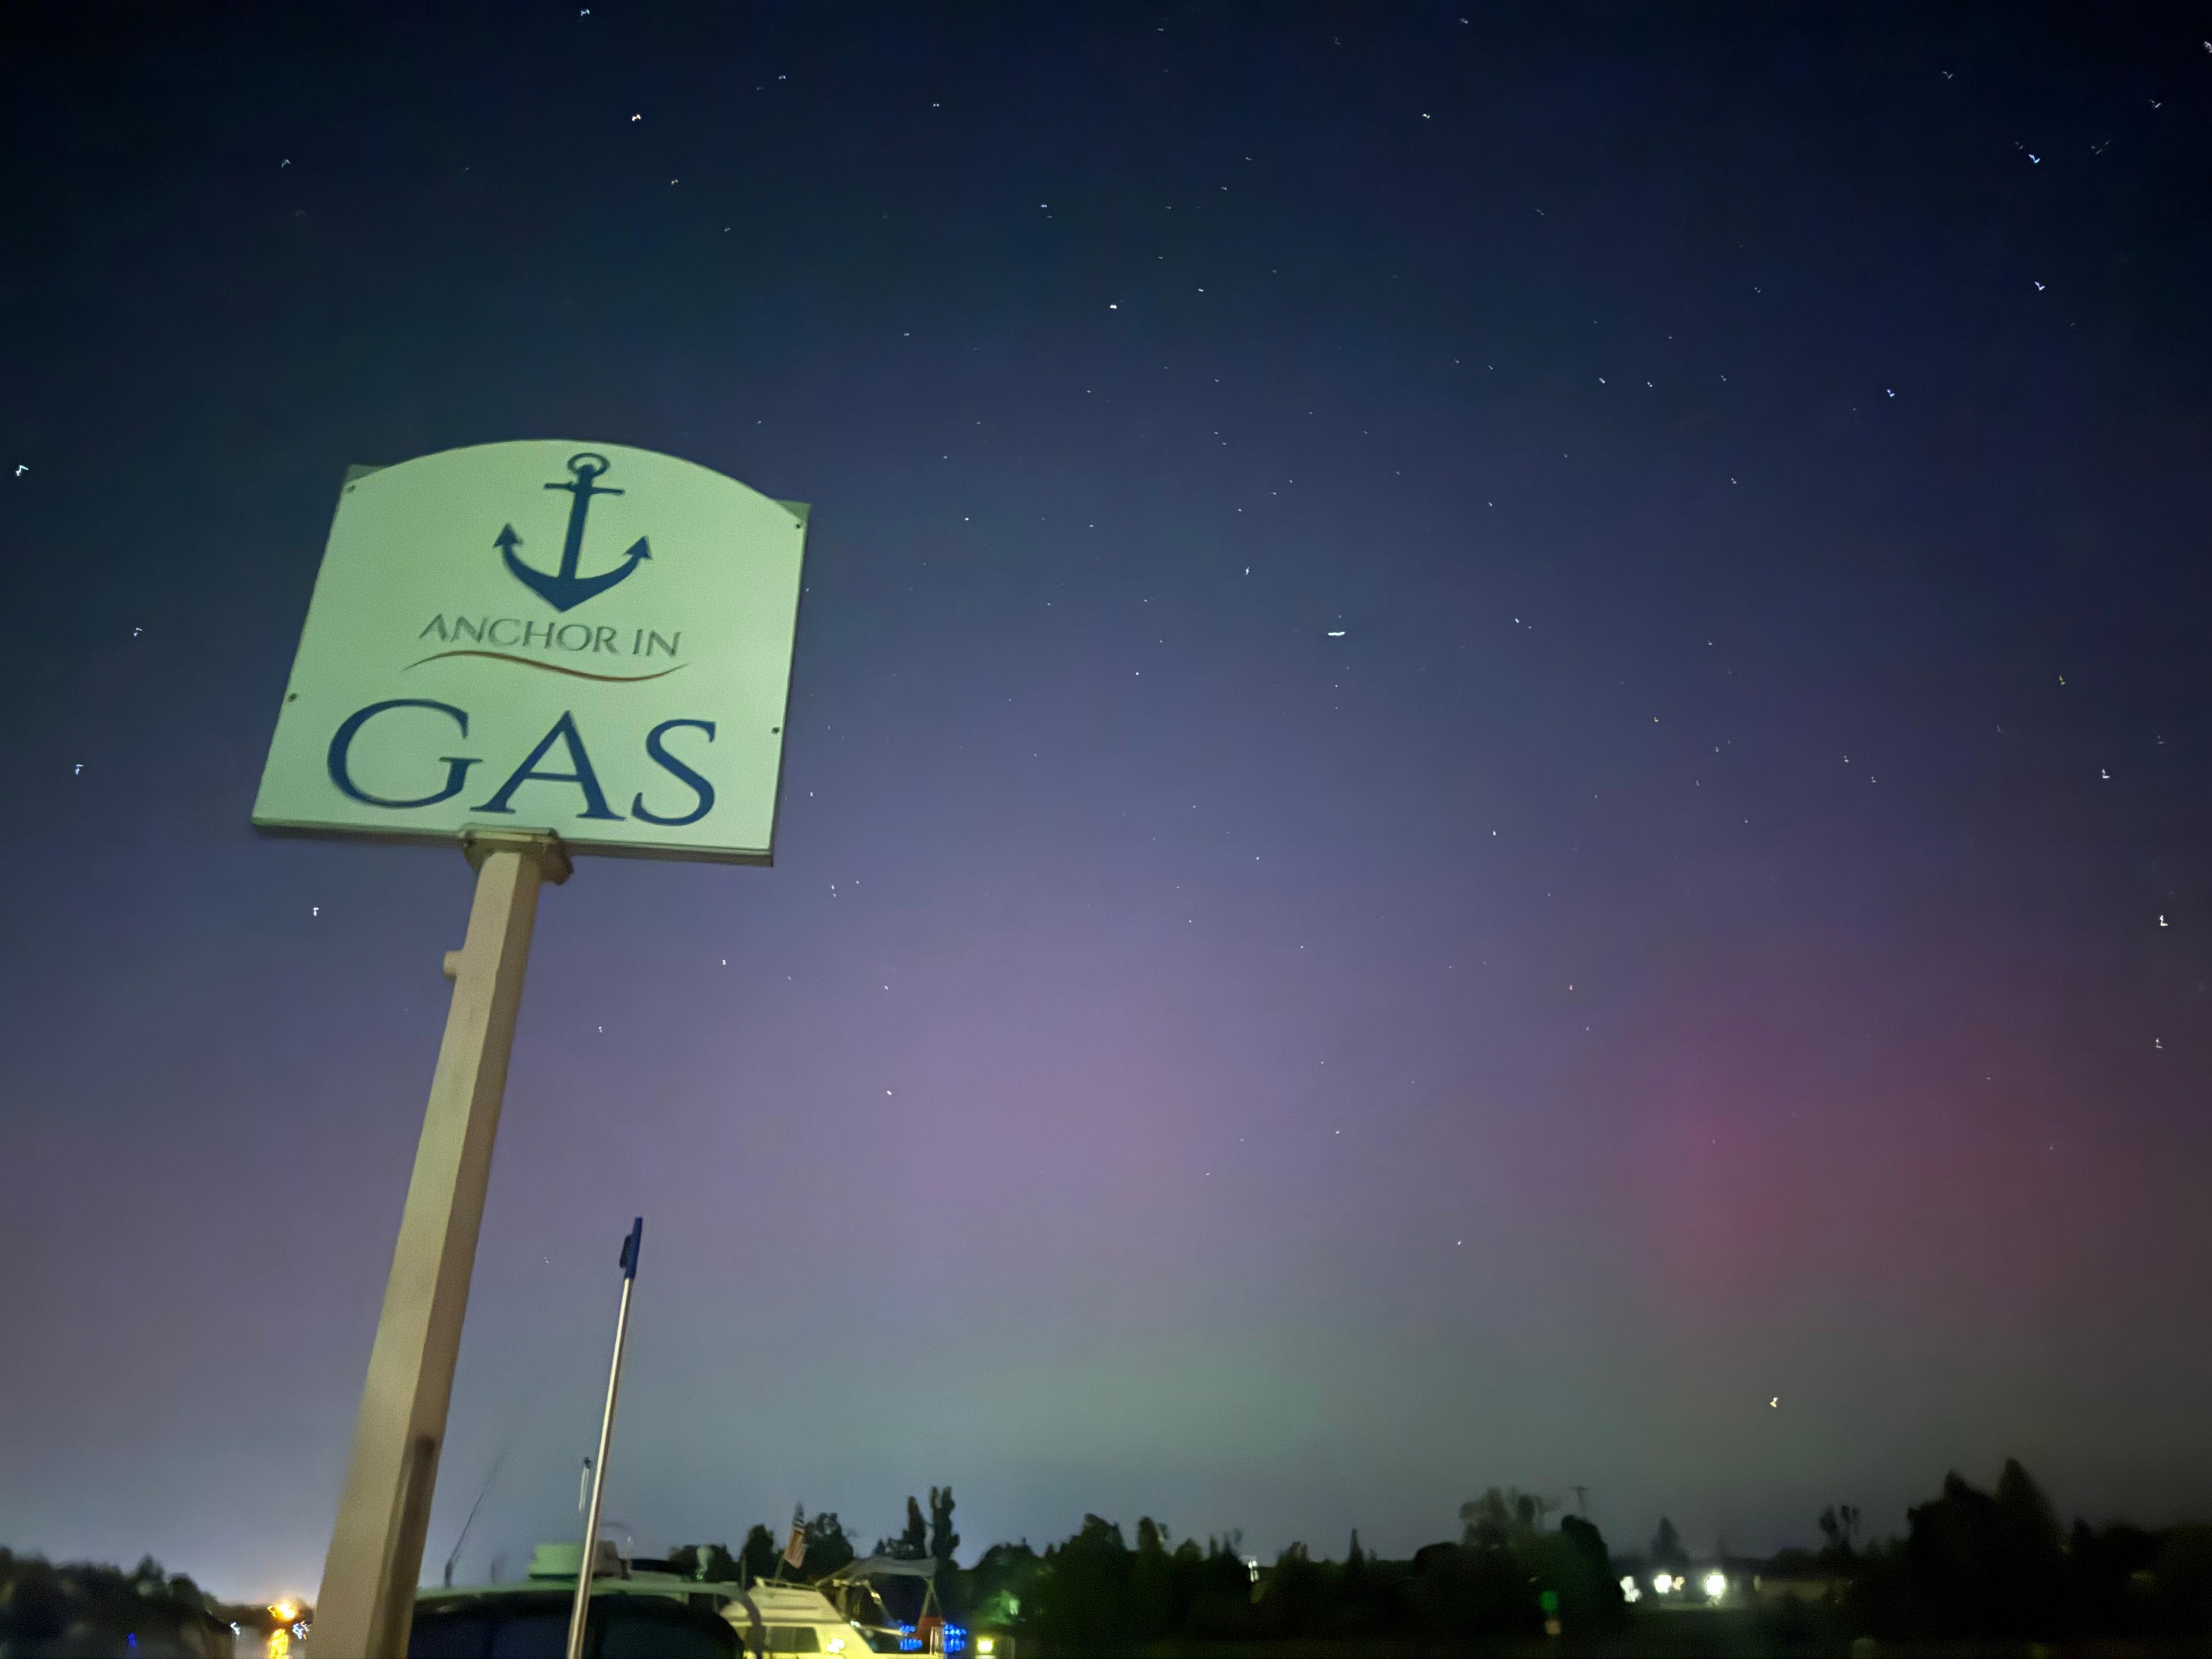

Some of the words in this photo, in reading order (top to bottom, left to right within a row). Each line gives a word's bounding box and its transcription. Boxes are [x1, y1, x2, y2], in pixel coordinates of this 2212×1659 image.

[419, 613, 620, 654] ANCHOR
[632, 628, 682, 658] IN
[327, 698, 717, 827] GAS
